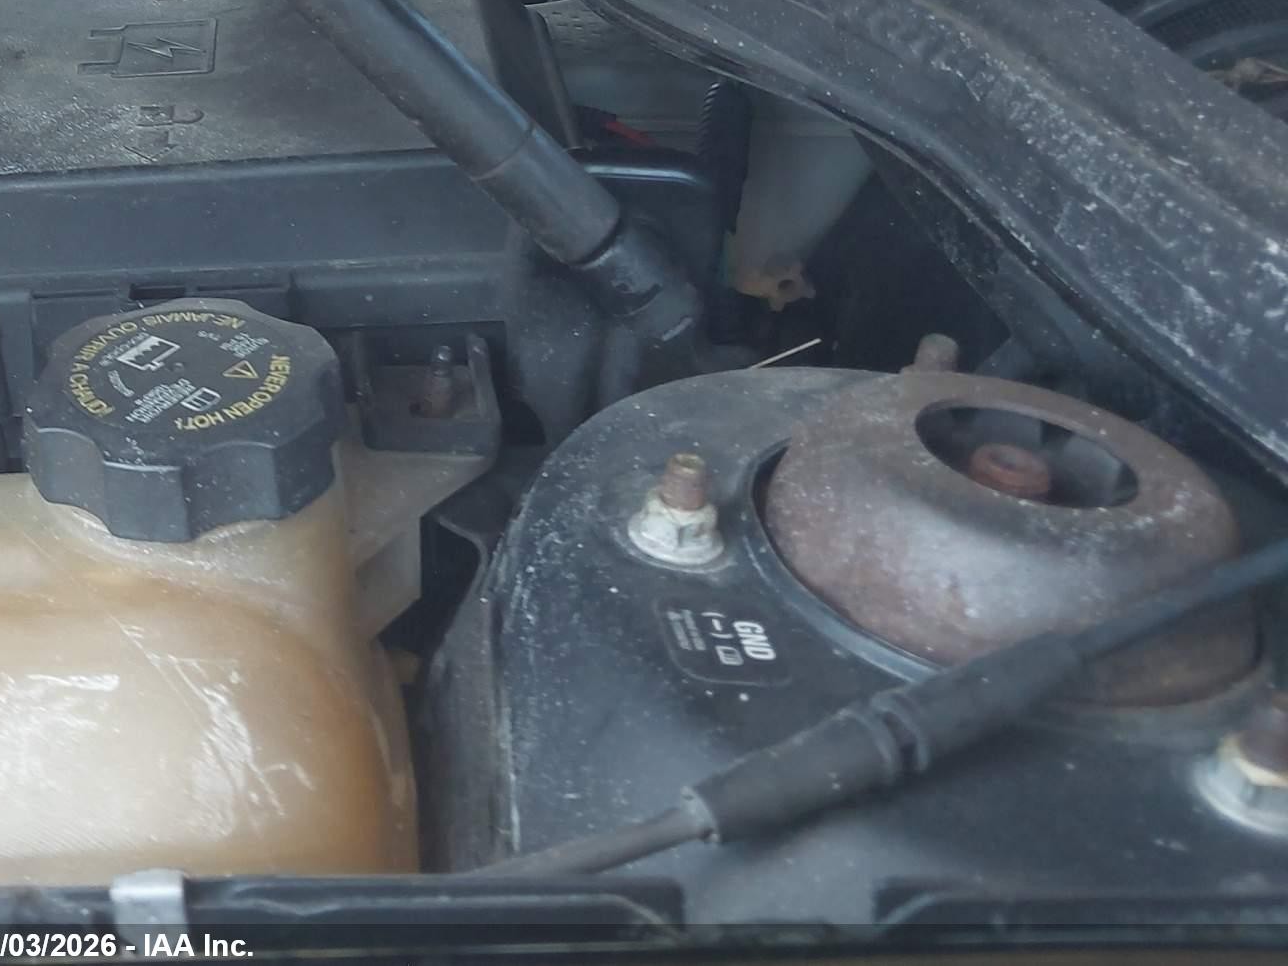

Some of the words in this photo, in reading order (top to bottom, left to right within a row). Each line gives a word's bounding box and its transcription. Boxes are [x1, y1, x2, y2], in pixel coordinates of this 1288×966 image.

[75, 322, 140, 361] OUVRIR
[263, 354, 291, 392] NEVER
[222, 391, 272, 420] OPEN
[733, 621, 776, 660] GND
